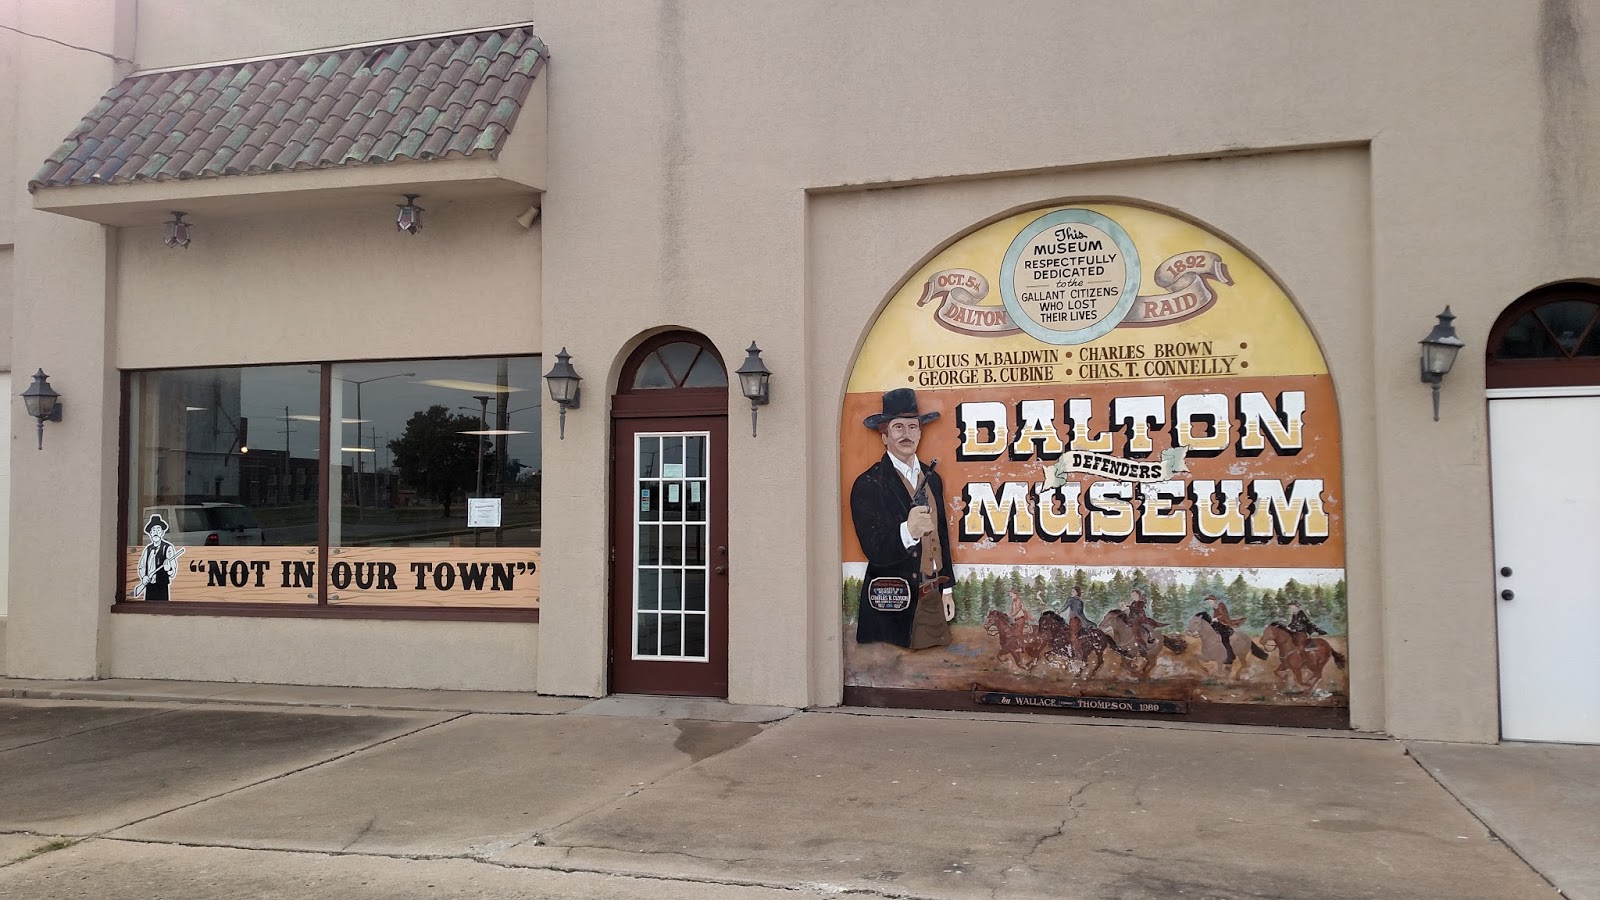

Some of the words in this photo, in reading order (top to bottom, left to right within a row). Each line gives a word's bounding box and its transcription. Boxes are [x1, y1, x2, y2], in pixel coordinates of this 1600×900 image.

[1054, 227, 1088, 242] This
[1033, 240, 1103, 255] MUSEUM
[1024, 253, 1117, 269] RESPECTFULLY
[1166, 255, 1206, 279] 1892
[937, 273, 965, 287] OCT.
[1033, 266, 1104, 280] DEDICATED
[1021, 290, 1066, 302] GALLANT
[1070, 286, 1119, 299] CITIZENS
[1039, 301, 1064, 312] WHO
[1068, 299, 1097, 310] LOST
[1143, 292, 1198, 318] RAID
[943, 302, 1008, 327] DALTON
[1040, 312, 1067, 322] THEIR
[1070, 310, 1098, 321] LIVES
[1079, 344, 1145, 361] CHARLES
[1154, 341, 1214, 358] BROWN
[917, 353, 970, 370] LUCIUS
[1079, 362, 1124, 379] CHAS.
[1125, 362, 1140, 378] T.
[1144, 357, 1236, 376] CONNELLY
[918, 369, 979, 386] GEORGE
[983, 368, 997, 383] B.
[999, 366, 1054, 383] CUBINE
[956, 391, 1306, 461] DALTON
[1072, 453, 1162, 479] DEFENDERS
[959, 479, 1329, 545] MUSEUM
[280, 560, 316, 588] IN
[330, 561, 398, 590] OUR
[1015, 697, 1057, 707] WALLACE
[1077, 699, 1133, 711] THOMPSON
